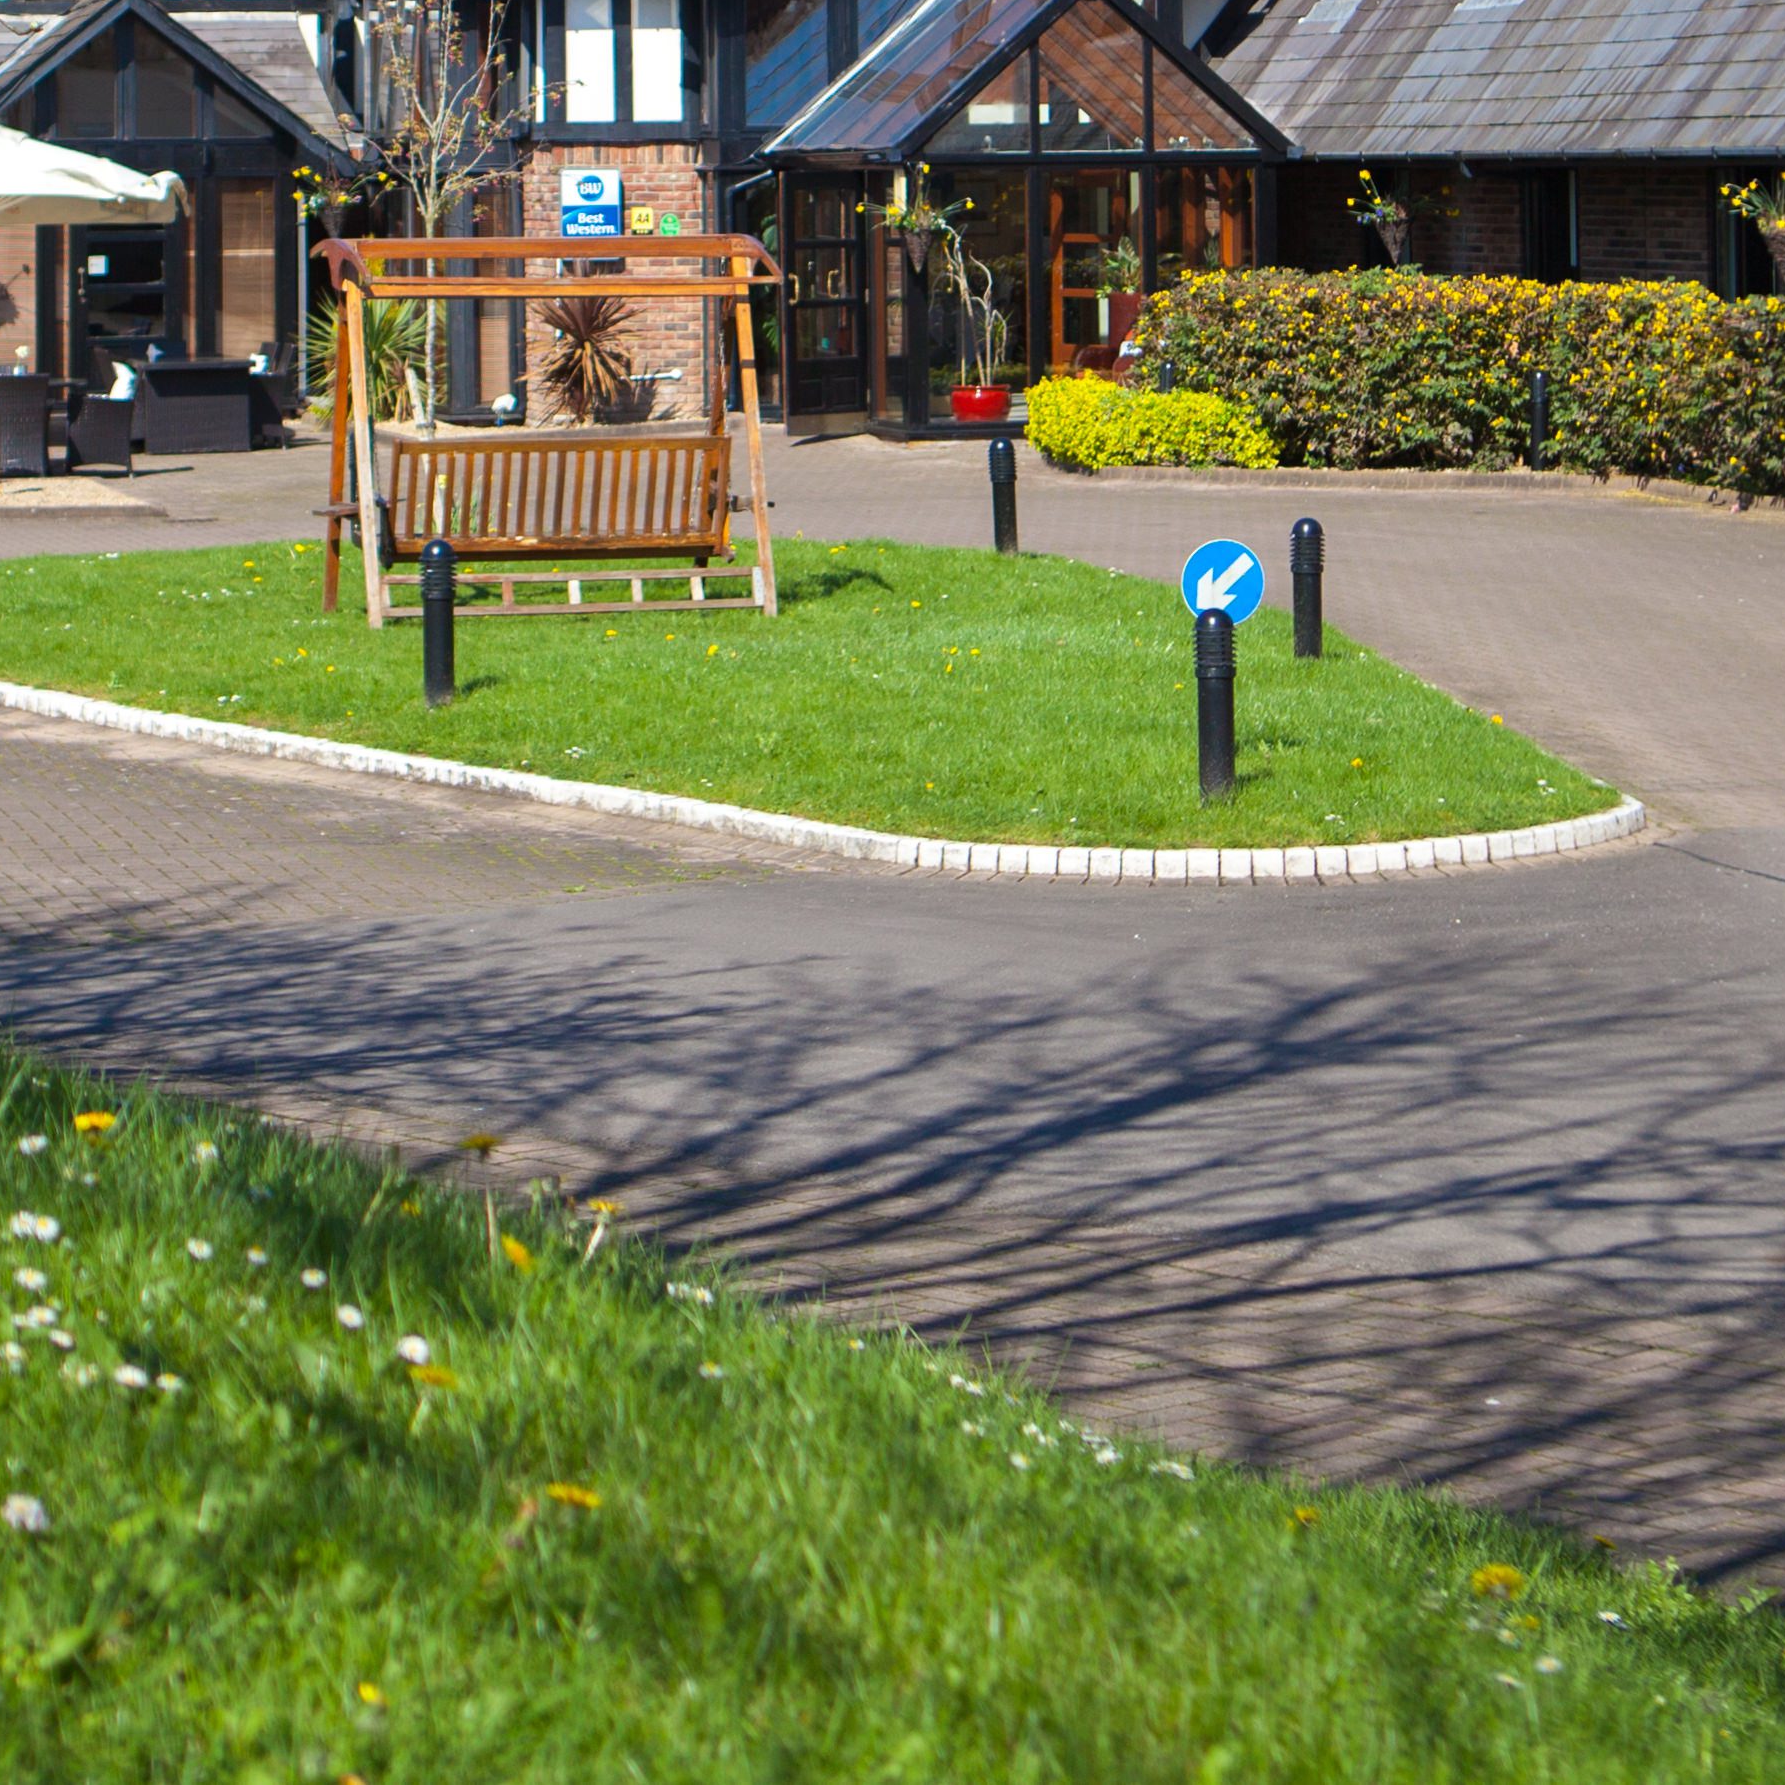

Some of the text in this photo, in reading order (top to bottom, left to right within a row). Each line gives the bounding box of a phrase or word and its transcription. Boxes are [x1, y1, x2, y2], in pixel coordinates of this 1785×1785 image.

[579, 182, 602, 195] BW
[577, 212, 604, 224] Best
[635, 213, 650, 223] AA
